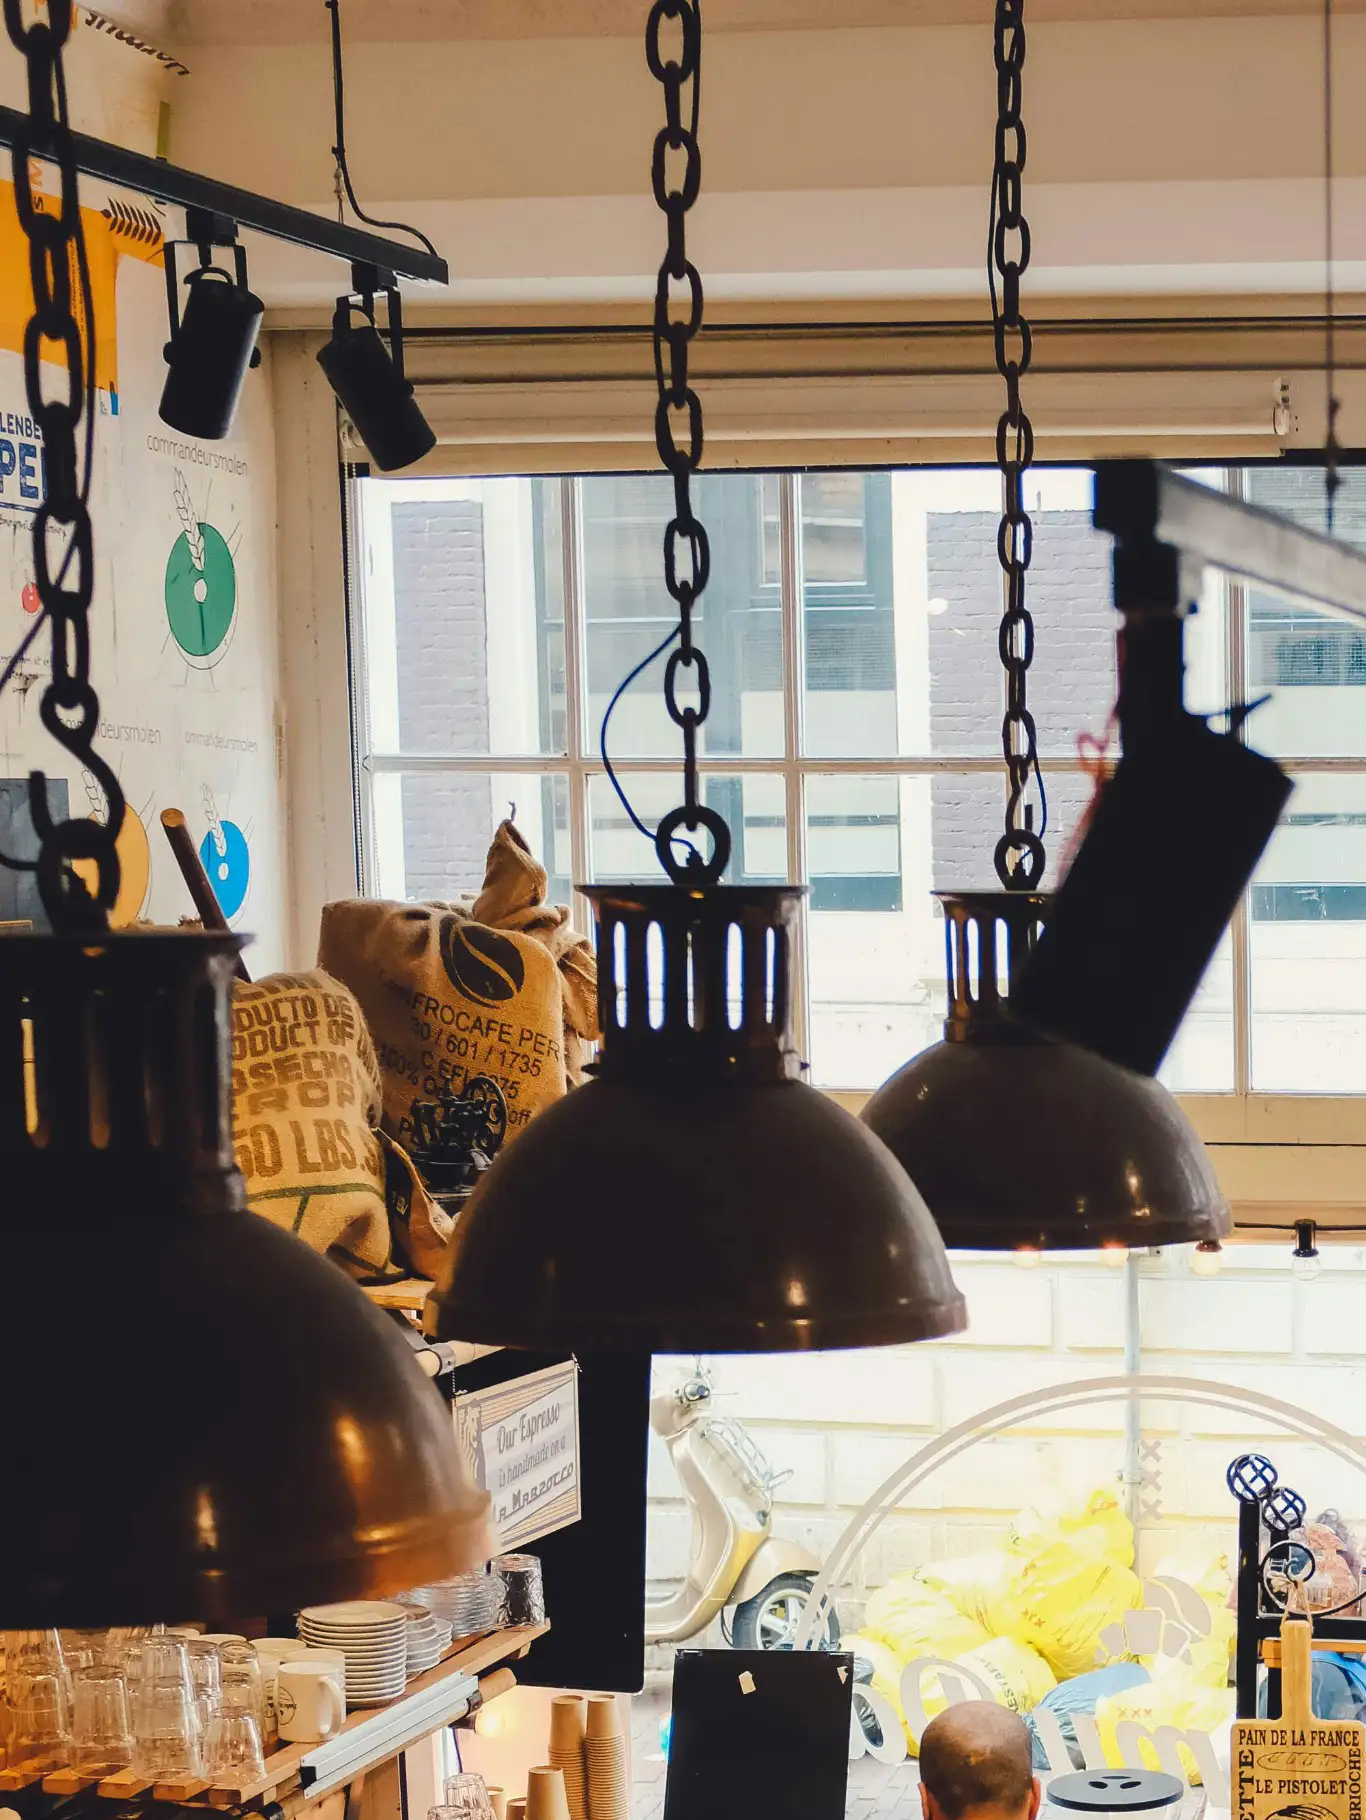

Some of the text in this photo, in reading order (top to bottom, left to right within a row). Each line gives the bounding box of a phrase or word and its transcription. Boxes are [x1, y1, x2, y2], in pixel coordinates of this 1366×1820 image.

[147, 434, 248, 477] commandeursmolen
[327, 1018, 355, 1046] OF
[446, 1034, 478, 1062] 601
[501, 1048, 542, 1077] 1735
[496, 1402, 560, 1455] Our Espresso
[507, 1442, 548, 1483] handmade
[1239, 1729, 1360, 1747] PAIN DE LA FRANCE
[1255, 1779, 1348, 1795] LE PISTOLET
